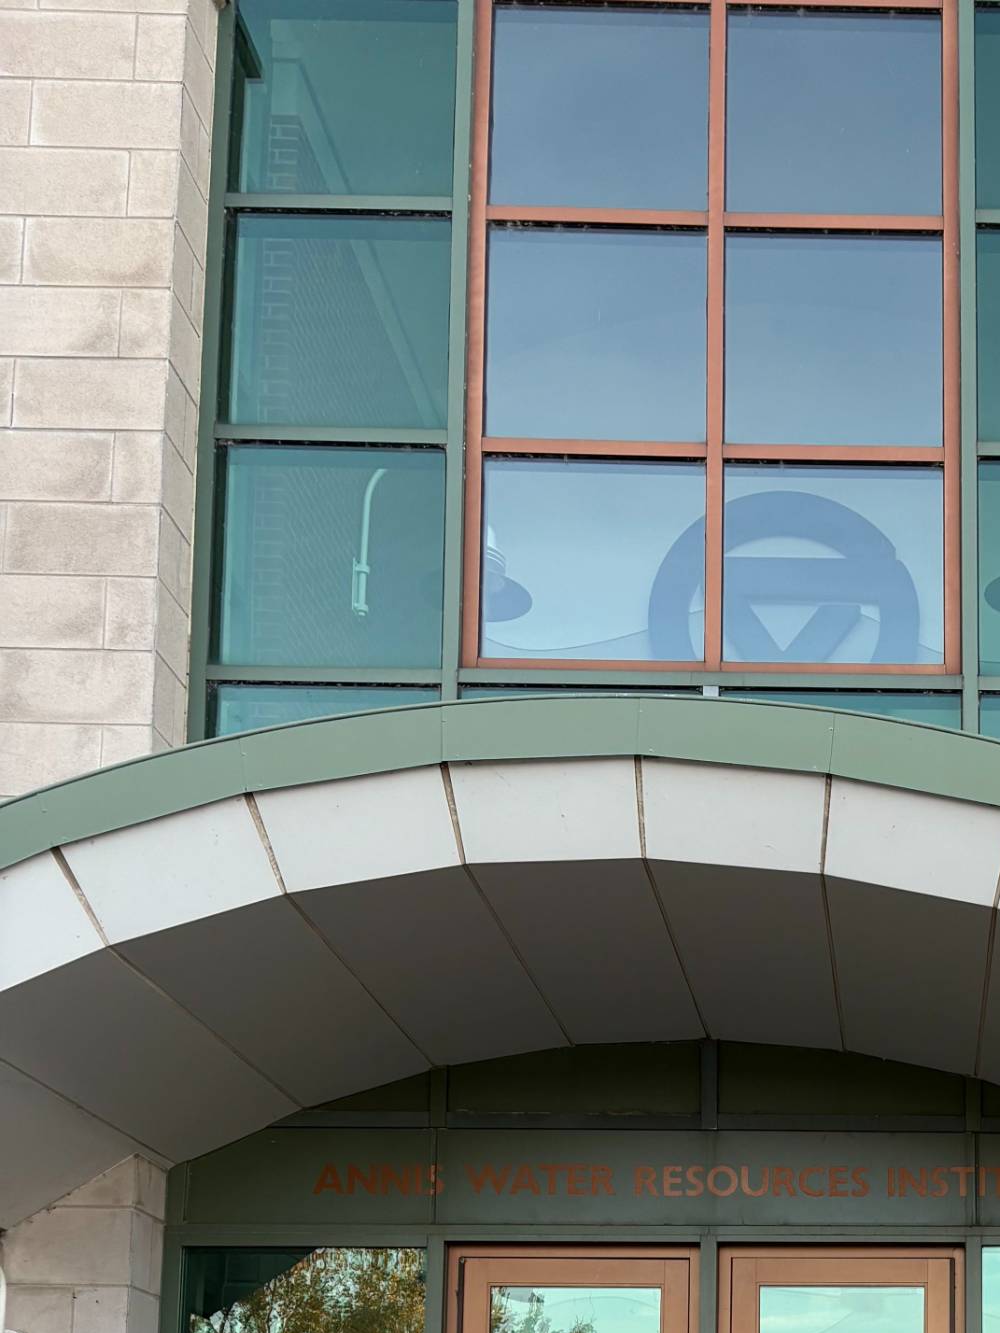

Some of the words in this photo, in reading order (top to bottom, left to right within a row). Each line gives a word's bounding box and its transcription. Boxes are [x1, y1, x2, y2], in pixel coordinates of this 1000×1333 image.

[313, 1163, 445, 1195] ANNIS
[463, 1163, 616, 1197] WATER
[633, 1165, 869, 1198] RESOURCES
